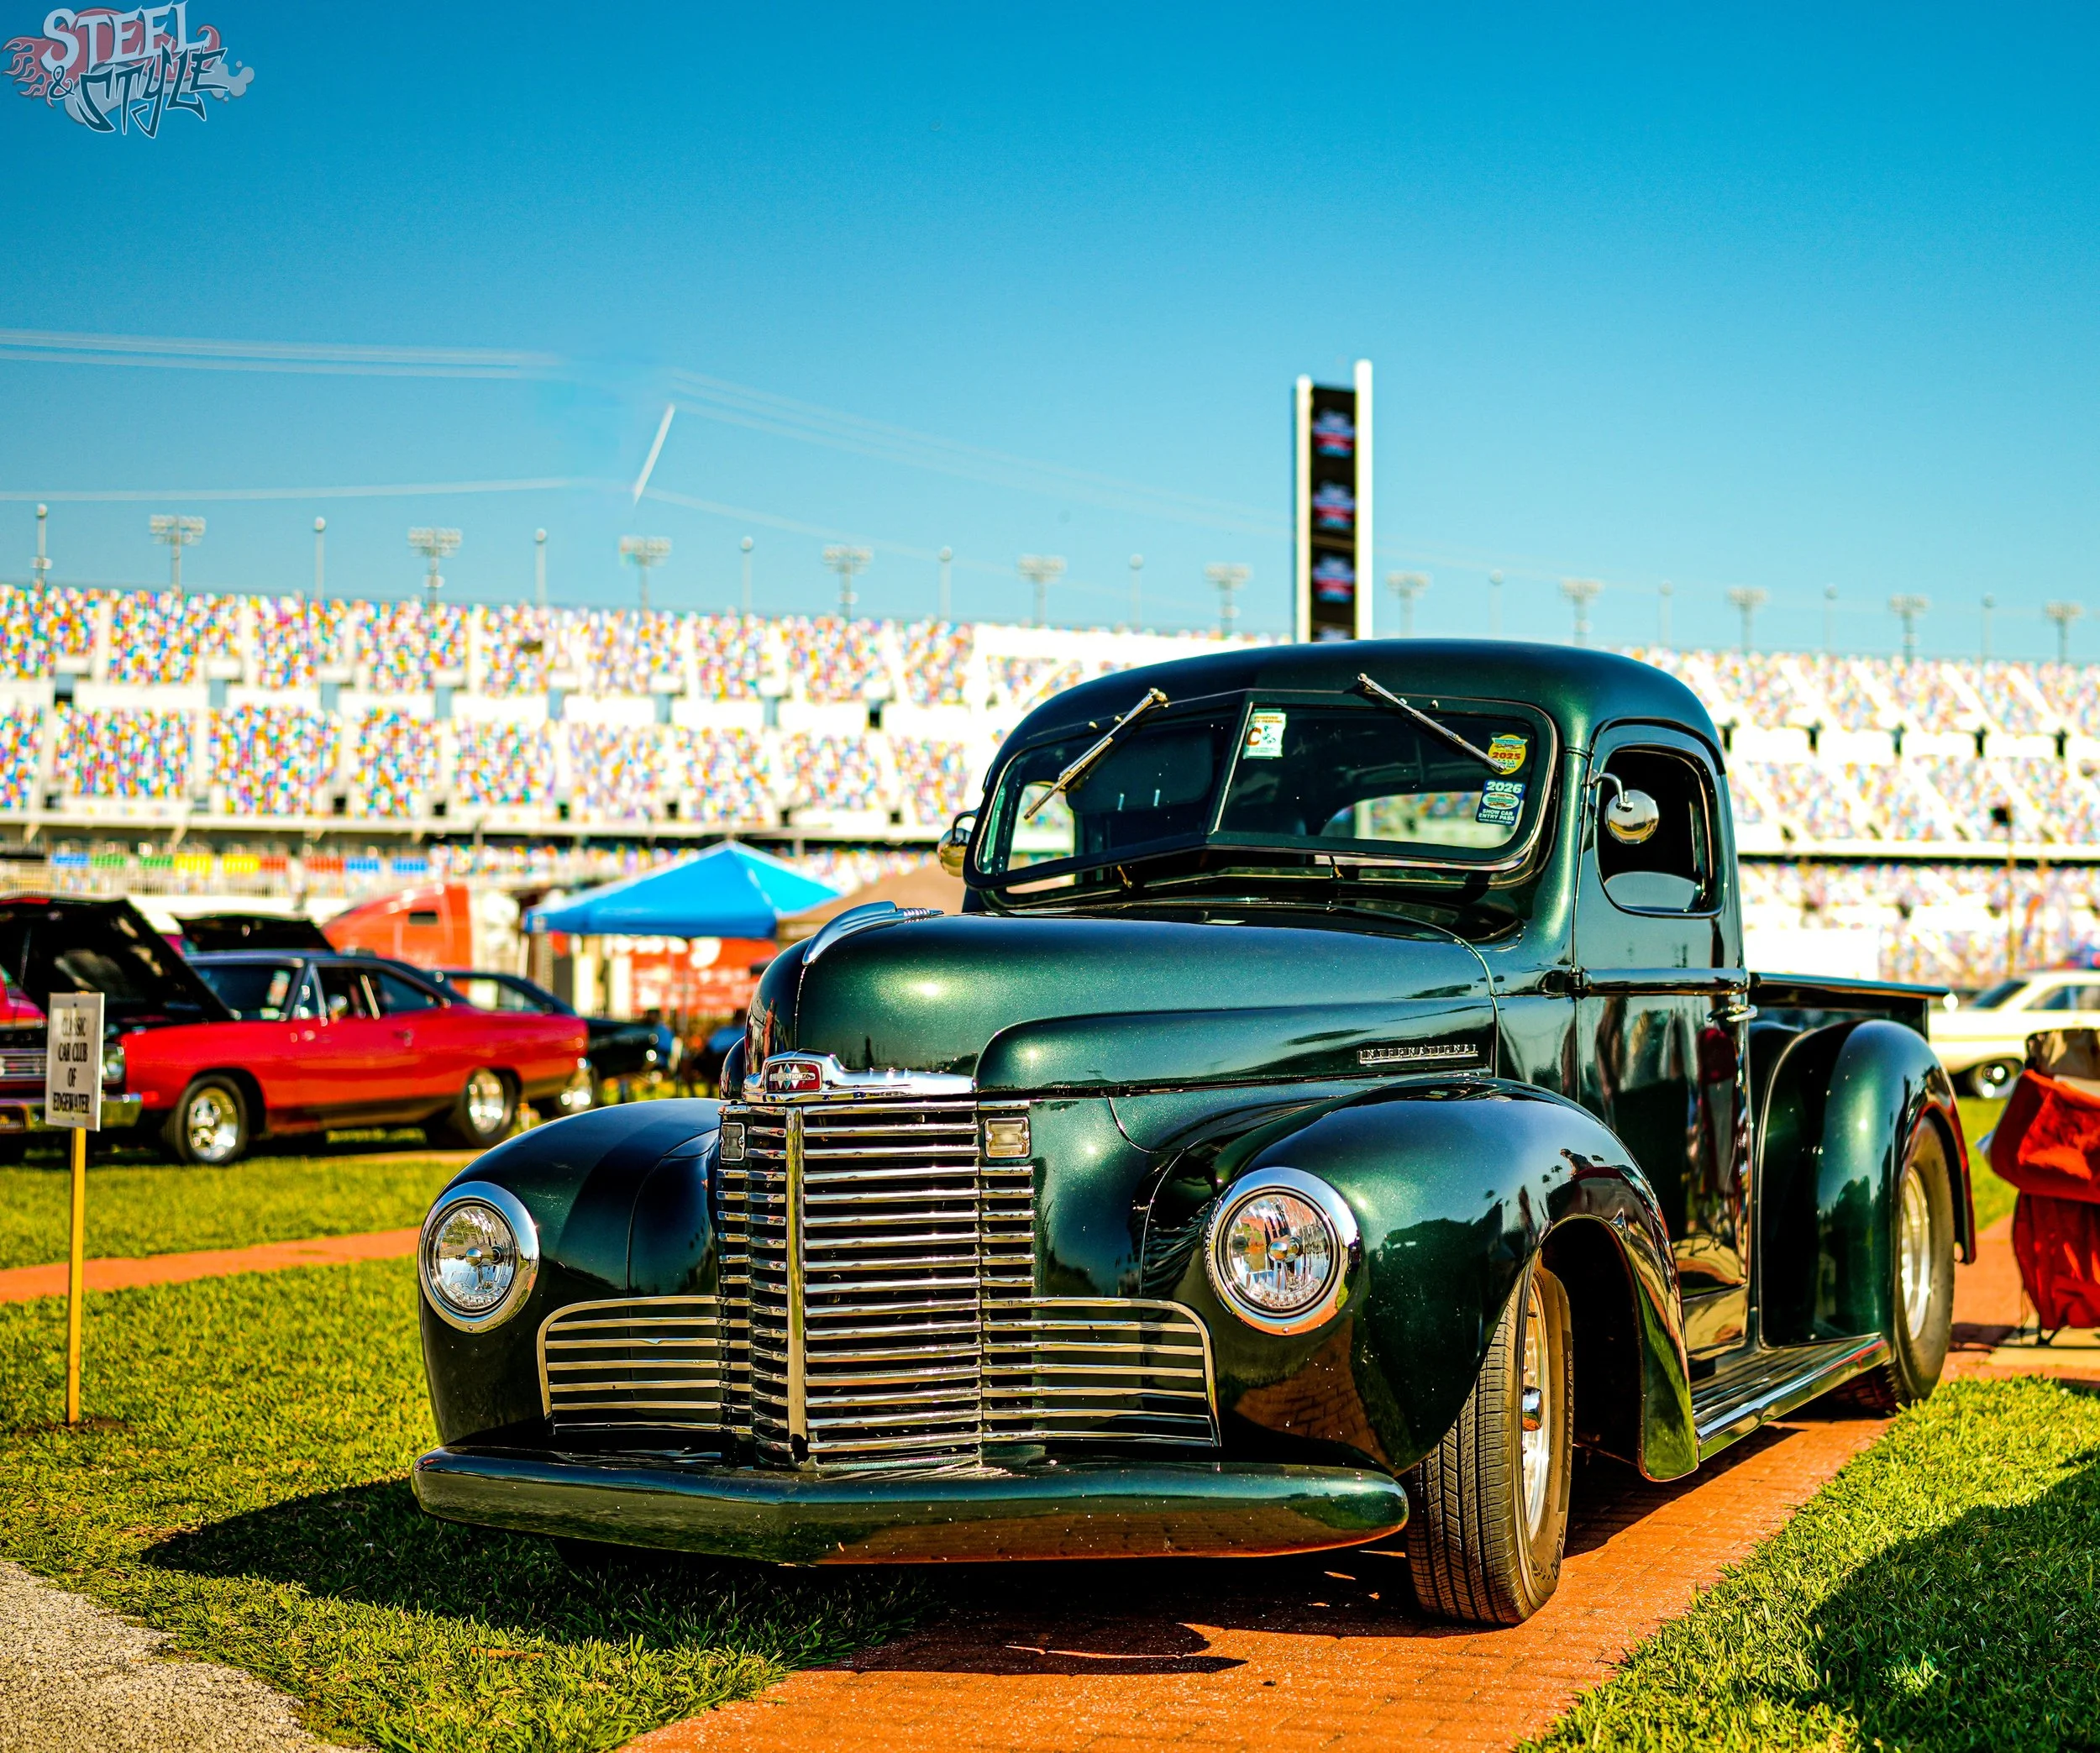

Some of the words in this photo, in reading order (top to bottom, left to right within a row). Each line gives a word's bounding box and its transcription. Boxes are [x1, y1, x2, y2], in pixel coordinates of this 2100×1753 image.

[1492, 752, 1521, 760] 2025
[1486, 780, 1522, 794] 2026
[58, 1042, 71, 1062] CAR
[72, 1042, 88, 1063] CLUB
[1357, 1044, 1478, 1062] INTERNATIONAL
[67, 1068, 77, 1088] OF
[53, 1092, 90, 1114] EDGEWATER
